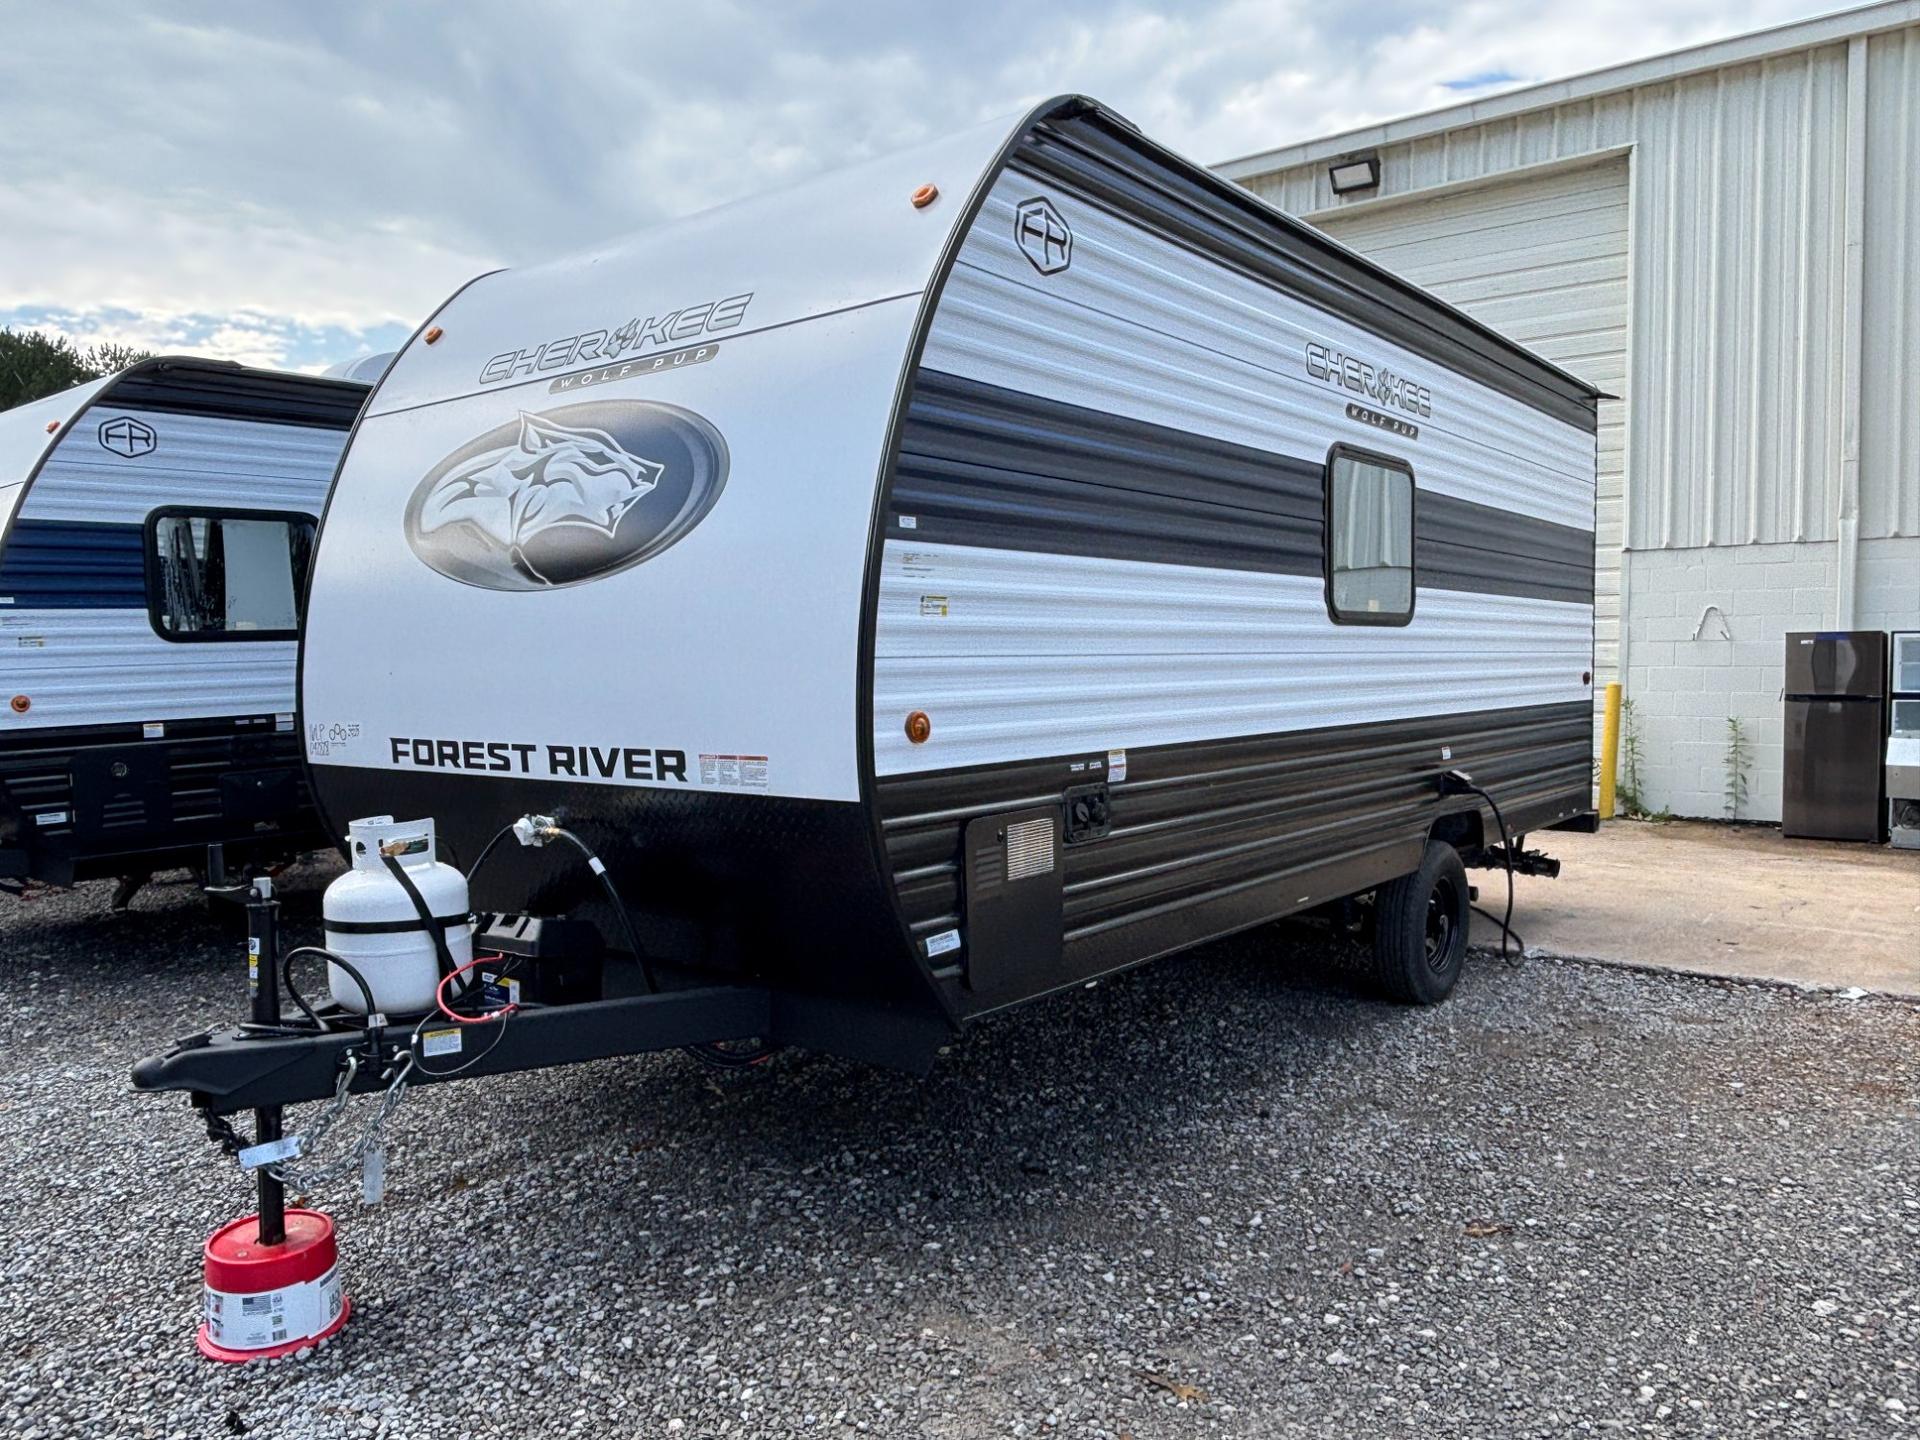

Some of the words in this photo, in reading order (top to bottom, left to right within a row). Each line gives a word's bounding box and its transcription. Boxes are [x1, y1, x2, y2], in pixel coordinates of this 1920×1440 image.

[560, 365, 631, 389] WOLF
[652, 349, 708, 370] PUP
[1351, 406, 1386, 425] WOLF
[1393, 421, 1416, 436] PUP
[389, 737, 537, 773] FOREST
[546, 745, 688, 782] RIVER
